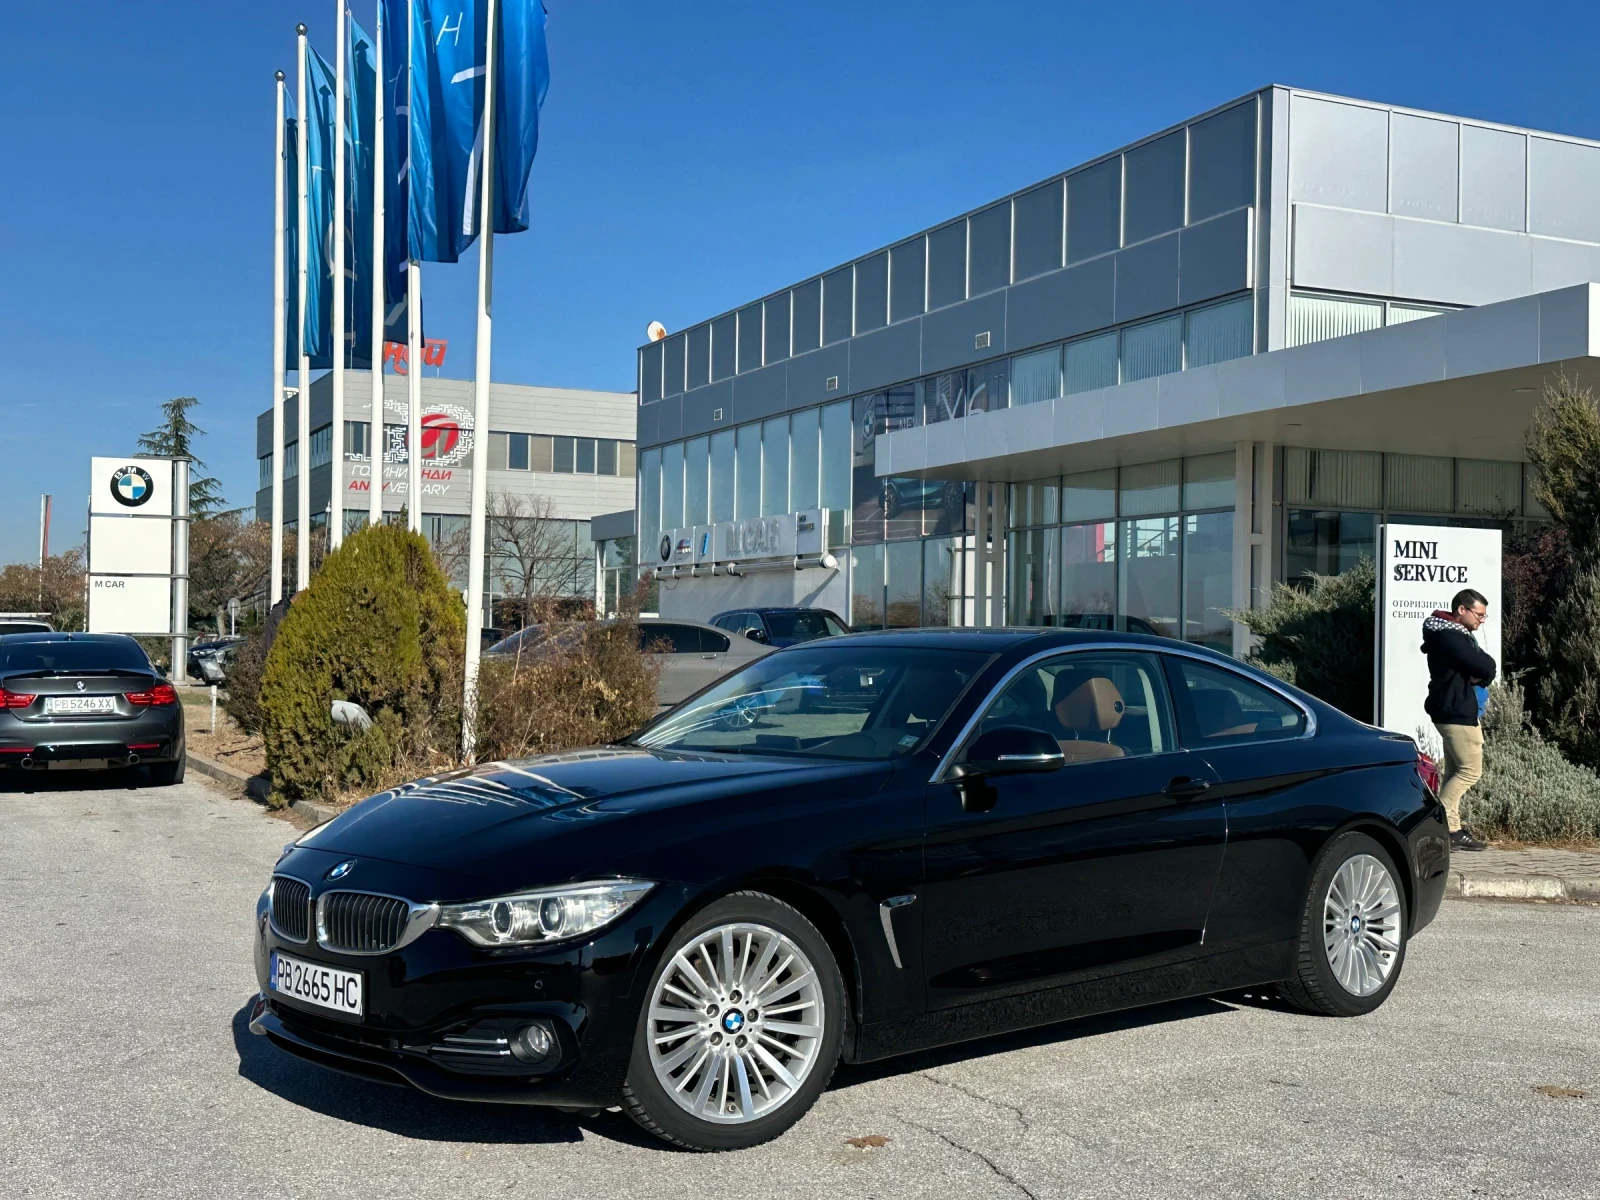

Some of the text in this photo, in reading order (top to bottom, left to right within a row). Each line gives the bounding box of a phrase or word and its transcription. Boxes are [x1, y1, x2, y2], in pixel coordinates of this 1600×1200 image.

[352, 465, 452, 480] ГОИНИ НДИ
[1393, 540, 1439, 560] MINI
[1393, 563, 1468, 583] SERVICE
[94, 580, 125, 589] M CAR
[1392, 600, 1449, 609] ОТОРИЗИРАН
[1392, 610, 1426, 619] СЕРВИЗ
[277, 958, 358, 1009] PB 2665 HC
